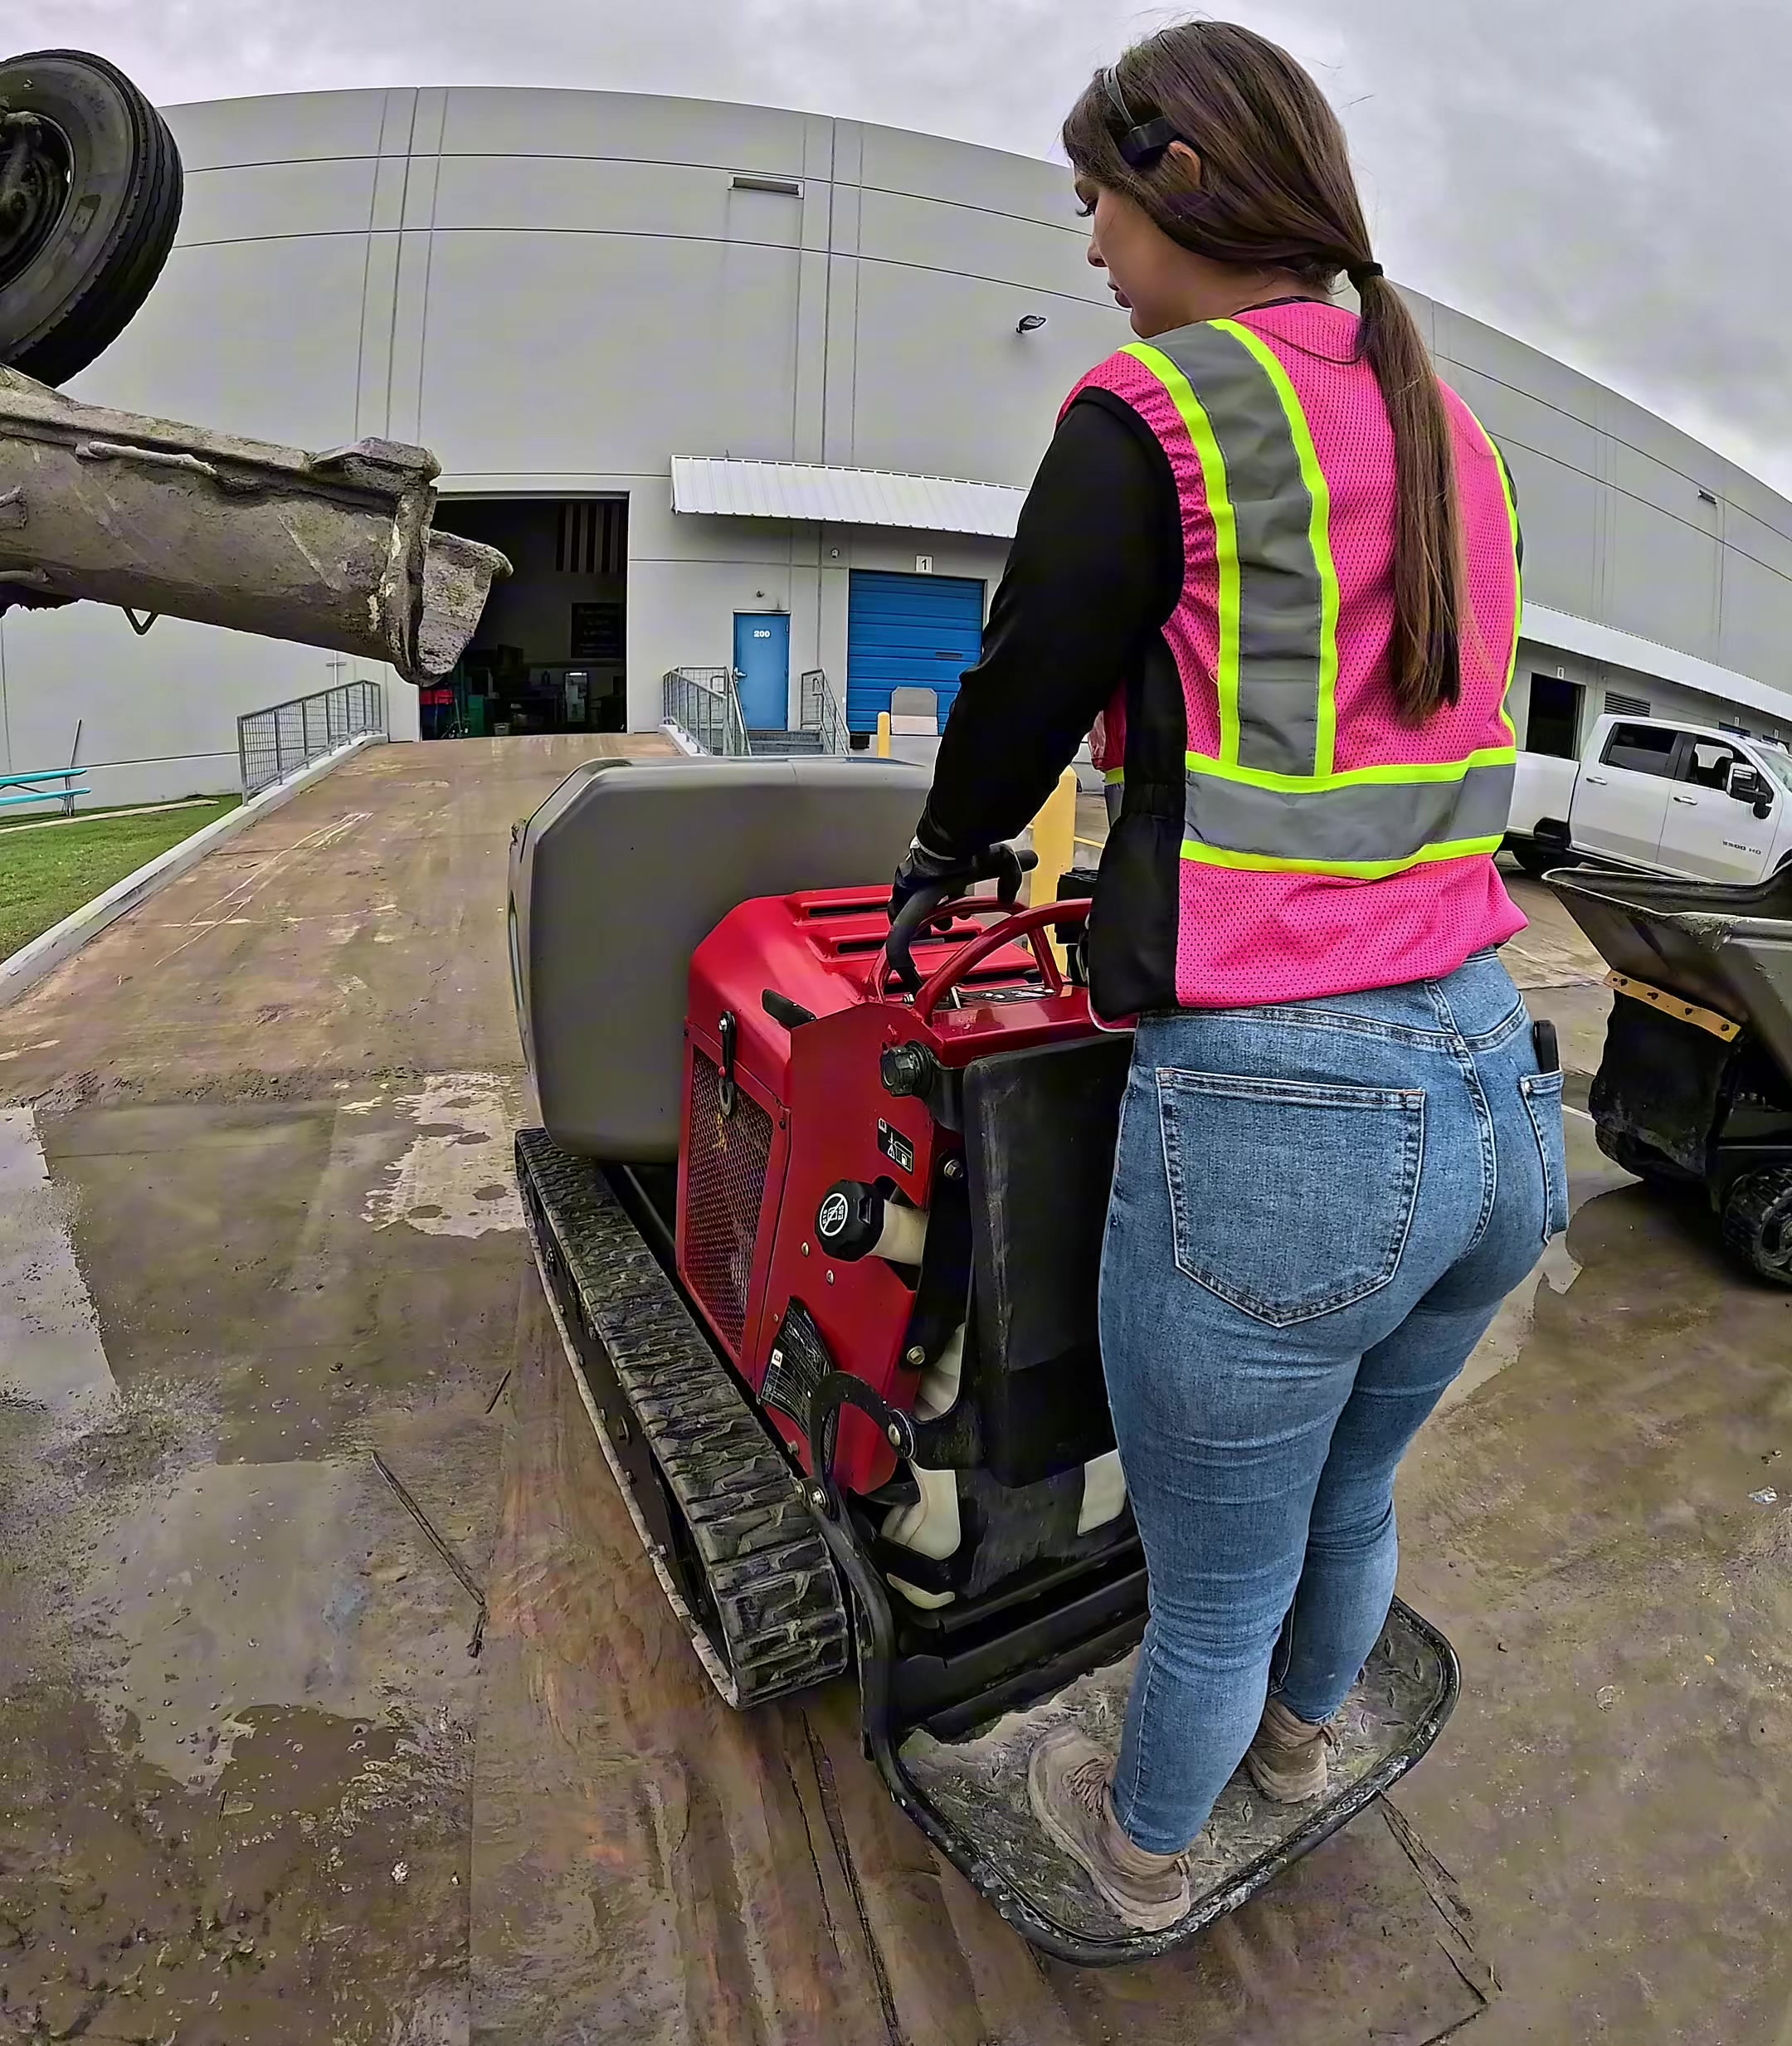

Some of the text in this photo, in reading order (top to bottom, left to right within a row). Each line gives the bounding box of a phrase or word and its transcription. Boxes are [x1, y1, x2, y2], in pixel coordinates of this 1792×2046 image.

[921, 558, 927, 571] 1
[753, 630, 771, 638] 200
[1748, 847, 1761, 855] HD
